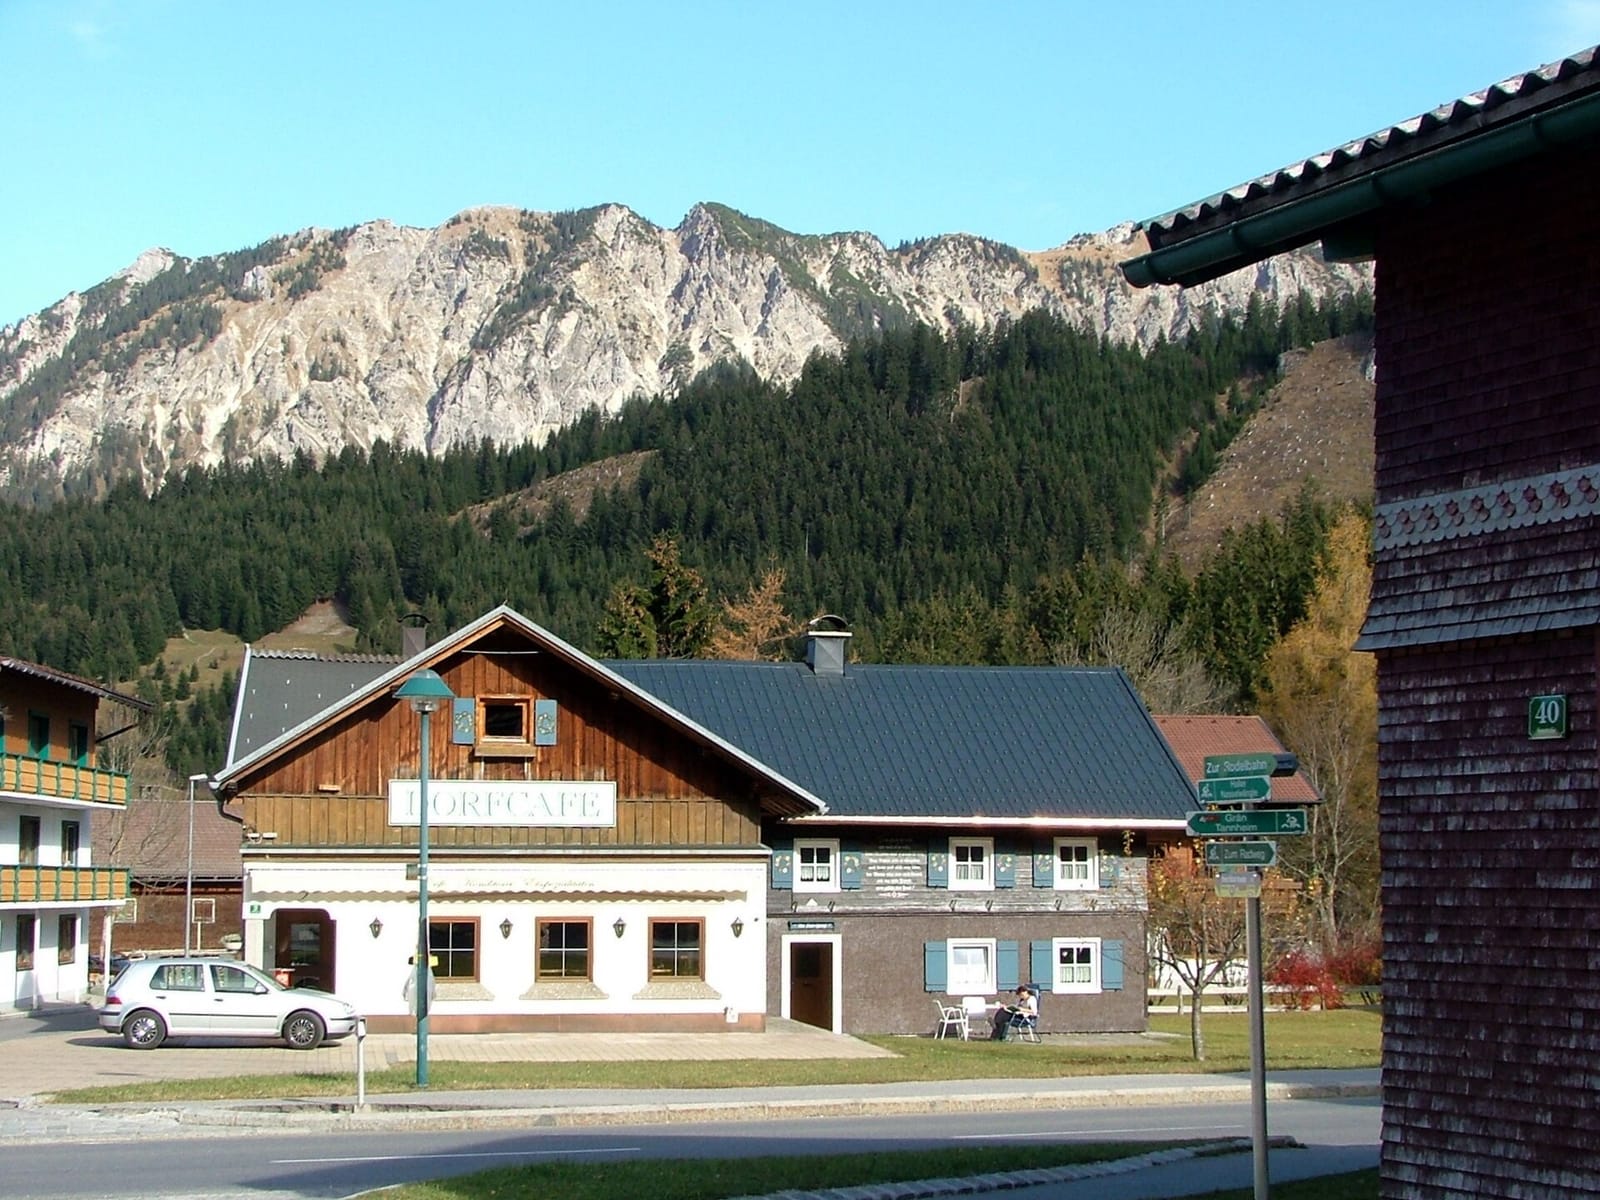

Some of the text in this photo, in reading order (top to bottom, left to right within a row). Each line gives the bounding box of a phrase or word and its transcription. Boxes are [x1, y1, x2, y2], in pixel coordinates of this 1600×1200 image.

[1535, 700, 1560, 724] 40
[1206, 759, 1267, 774] Zur Rodelbahn
[1224, 813, 1248, 823] Grän
[1215, 823, 1258, 832] Tannheim
[1224, 848, 1265, 861] Zum Radweg
